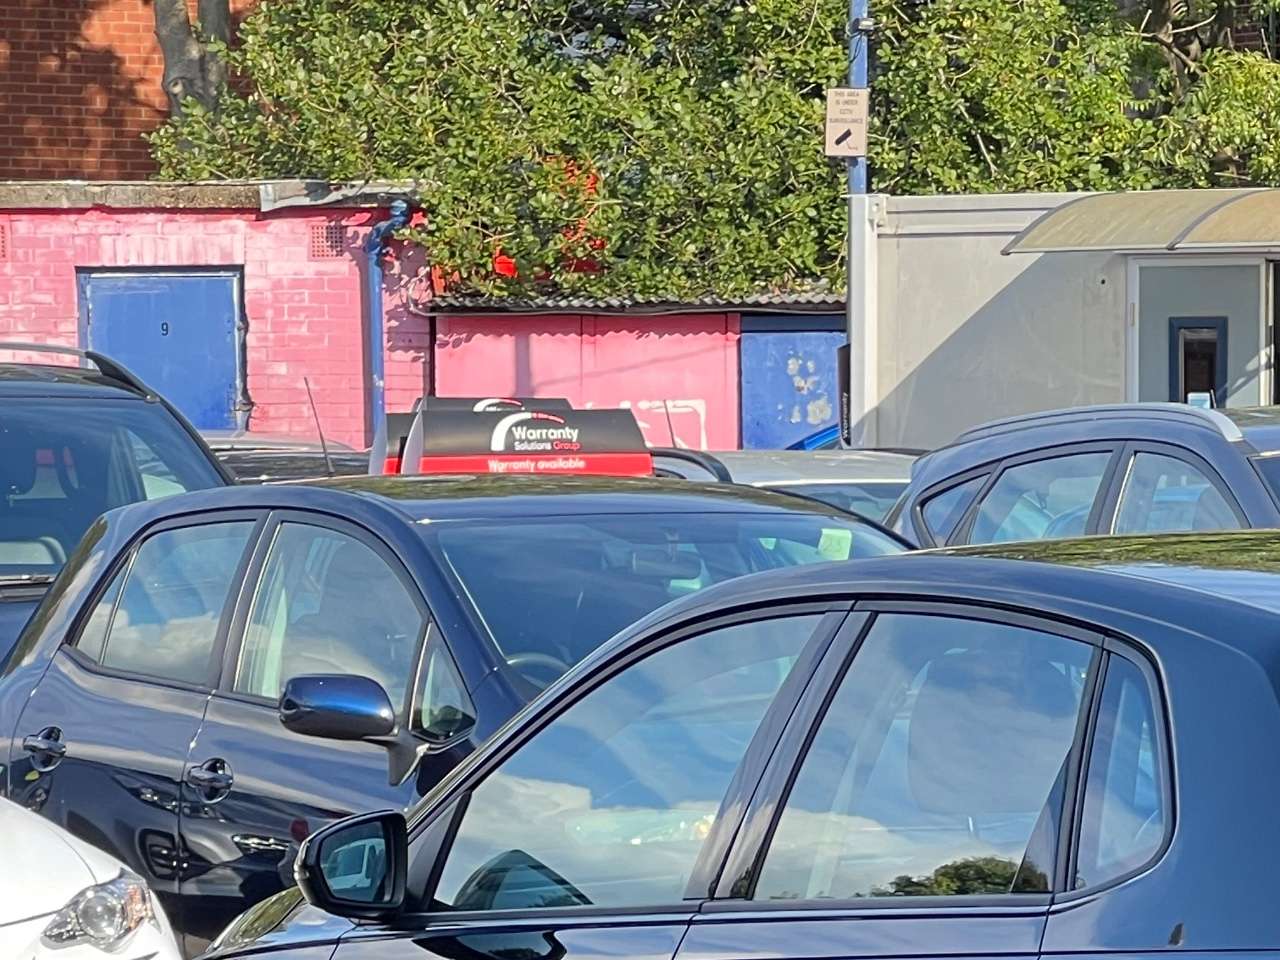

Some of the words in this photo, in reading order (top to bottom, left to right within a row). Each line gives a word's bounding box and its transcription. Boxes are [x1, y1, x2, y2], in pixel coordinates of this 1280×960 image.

[161, 322, 169, 336] 9
[512, 426, 578, 442] Warranty
[514, 441, 552, 450] Solutions
[553, 441, 581, 451] Group
[488, 459, 535, 472] Warranty
[537, 459, 586, 469] available
